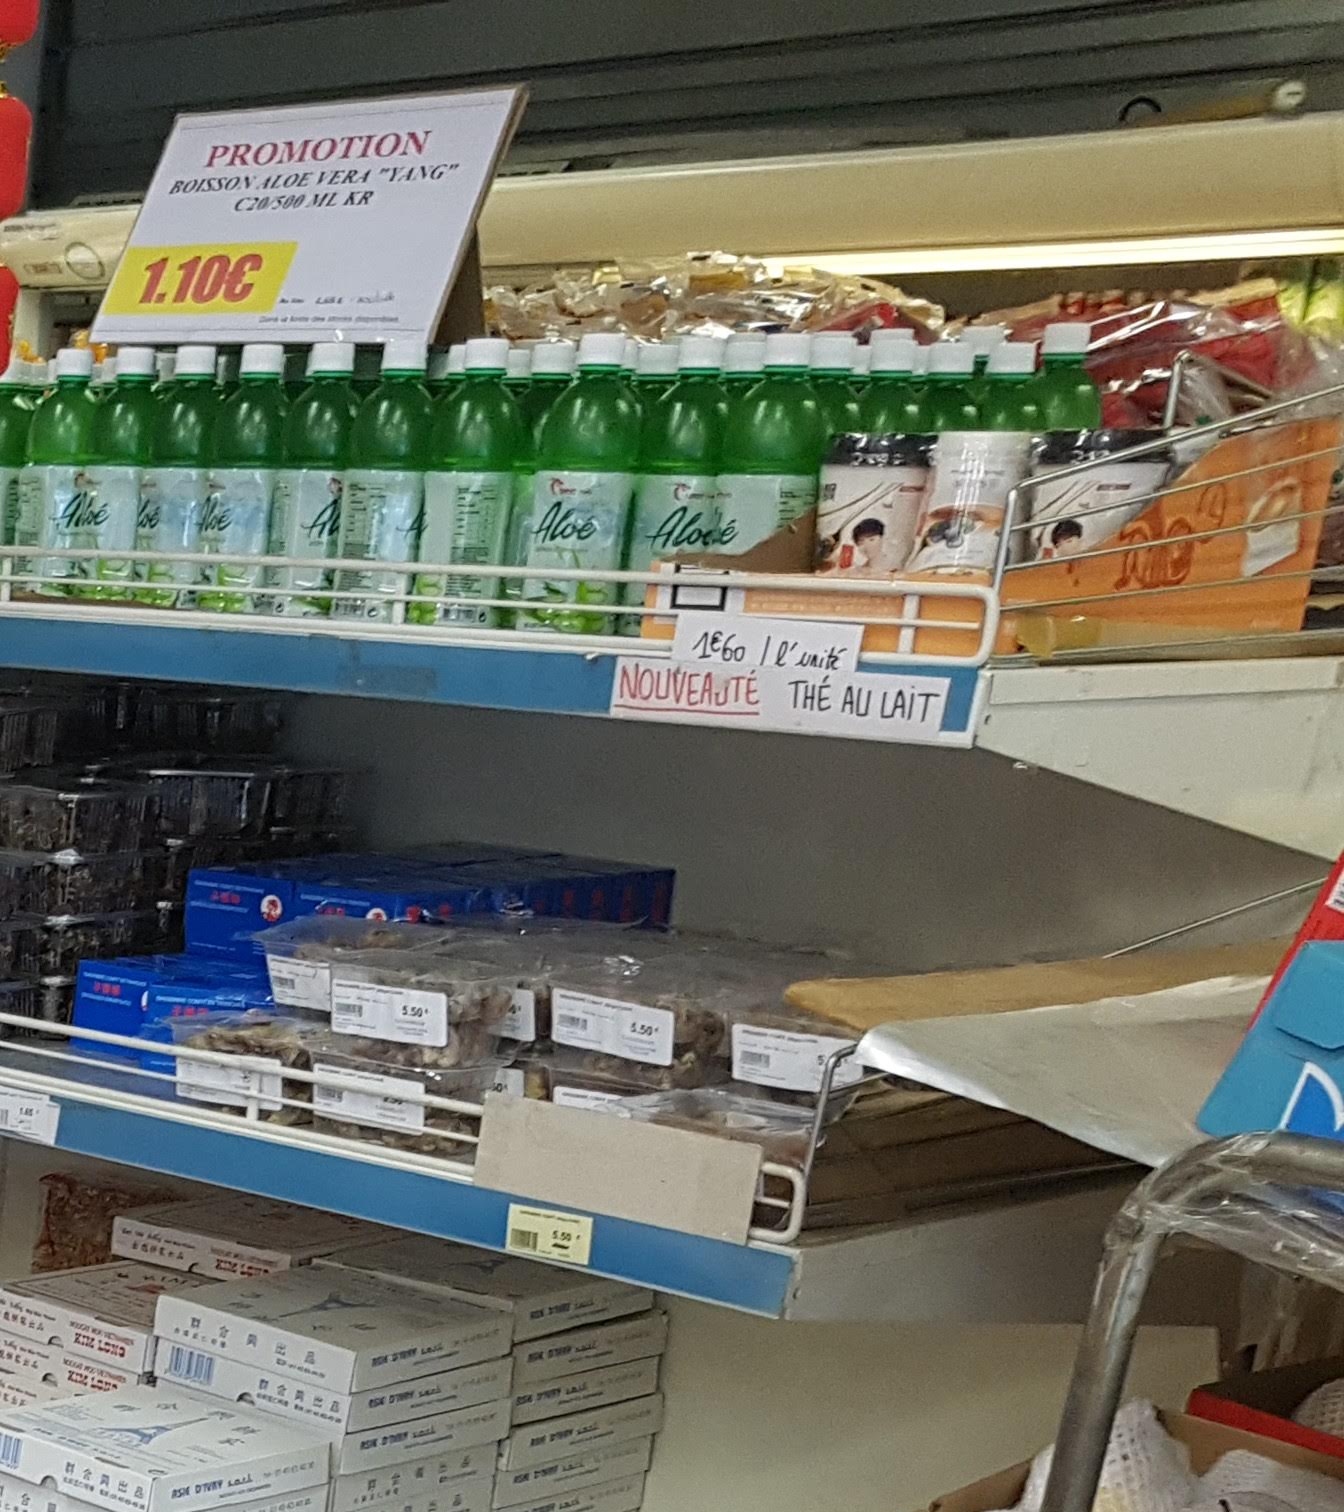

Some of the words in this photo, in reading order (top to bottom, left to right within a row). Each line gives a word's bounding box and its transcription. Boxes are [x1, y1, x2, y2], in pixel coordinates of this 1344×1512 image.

[205, 130, 432, 168] PROMOTION
[169, 174, 258, 196] BOISSON
[258, 172, 313, 190] ALOE
[315, 168, 371, 186] VERA
[378, 163, 460, 183] "YANG"
[233, 194, 304, 212] C20/500
[309, 193, 341, 208] ML
[343, 190, 375, 206] KR
[138, 253, 263, 305] 1.10€
[531, 501, 597, 544] Aloé
[618, 664, 760, 708] NOUVEAUTÉ
[787, 676, 832, 713] THÉ
[841, 684, 870, 718] AU
